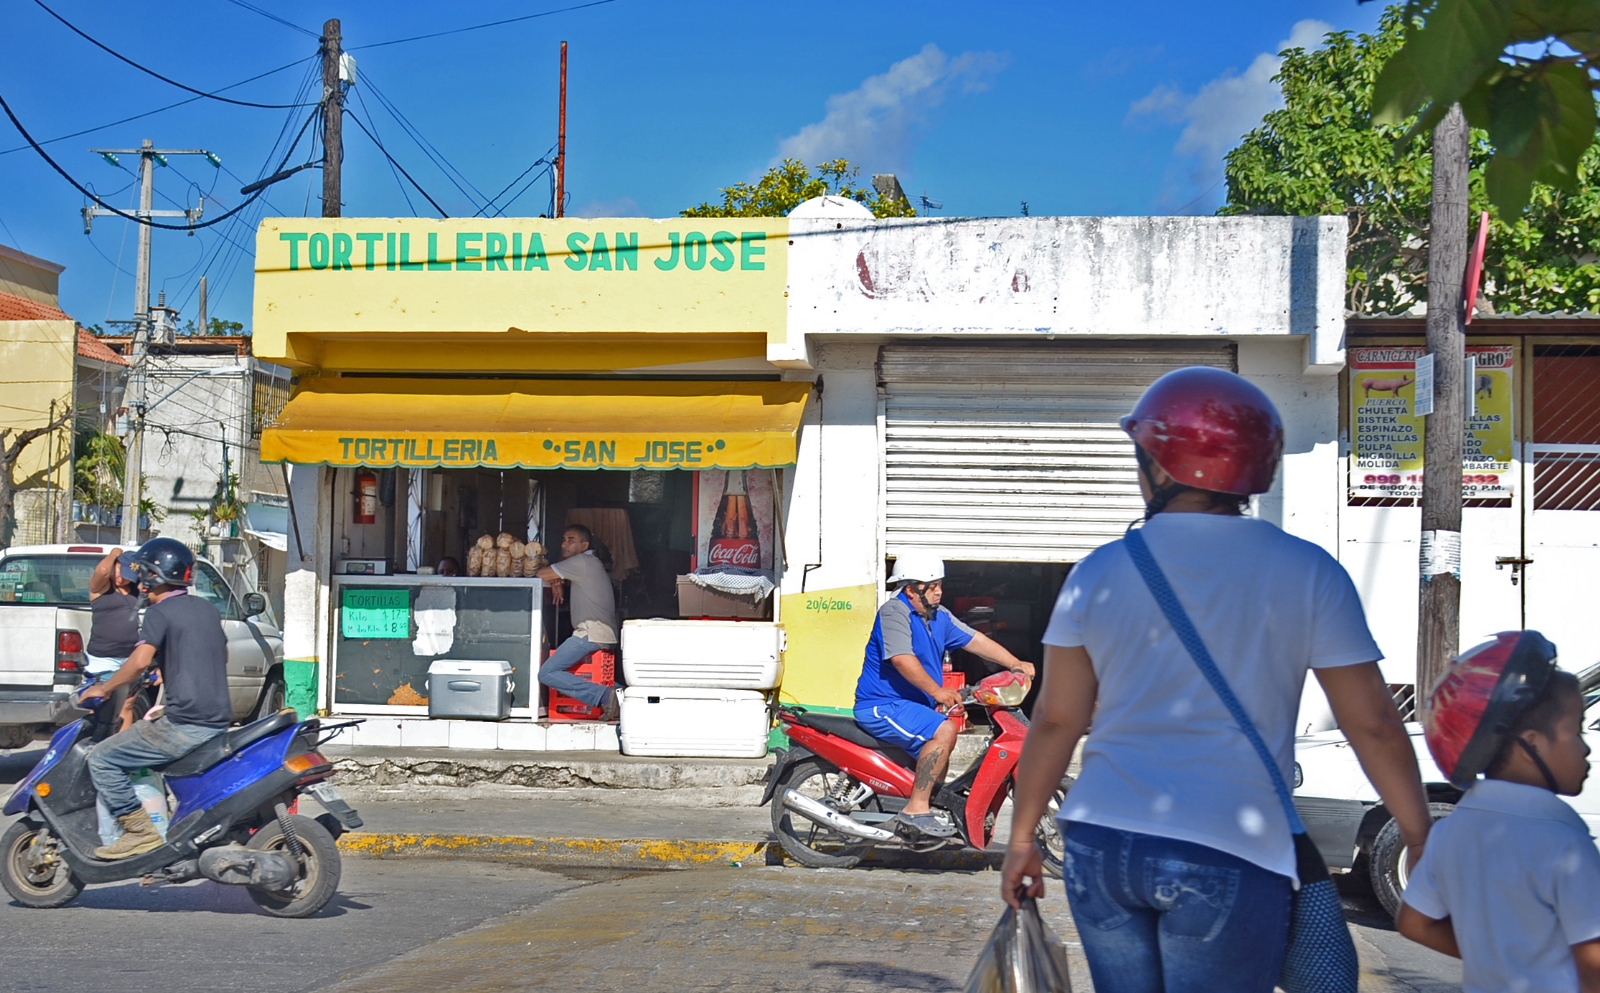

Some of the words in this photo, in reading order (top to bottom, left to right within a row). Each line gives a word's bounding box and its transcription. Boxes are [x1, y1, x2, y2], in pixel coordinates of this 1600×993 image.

[279, 232, 550, 272] TORTILLERIA
[564, 231, 638, 272] SAN
[654, 230, 766, 272] JOSE
[1366, 398, 1407, 406] PUERCO
[1357, 407, 1408, 415] CHULETA
[1357, 416, 1397, 424] BISTEK
[1358, 425, 1413, 433] ESPINAZO
[1357, 434, 1418, 442] COSTILLAS
[338, 437, 498, 461] TORTILLERIA
[564, 440, 616, 463] SAN
[634, 440, 702, 463] JOSE
[1357, 443, 1393, 451] PULPA
[1357, 452, 1417, 460] HIGADILLA
[1357, 460, 1400, 468] MOLIDA
[1363, 473, 1401, 485] 998
[349, 595, 401, 607] TORTILLAS
[806, 596, 852, 614] 20/6/2016
[349, 610, 367, 621] Kilo
[869, 778, 889, 792] YAMAHA
